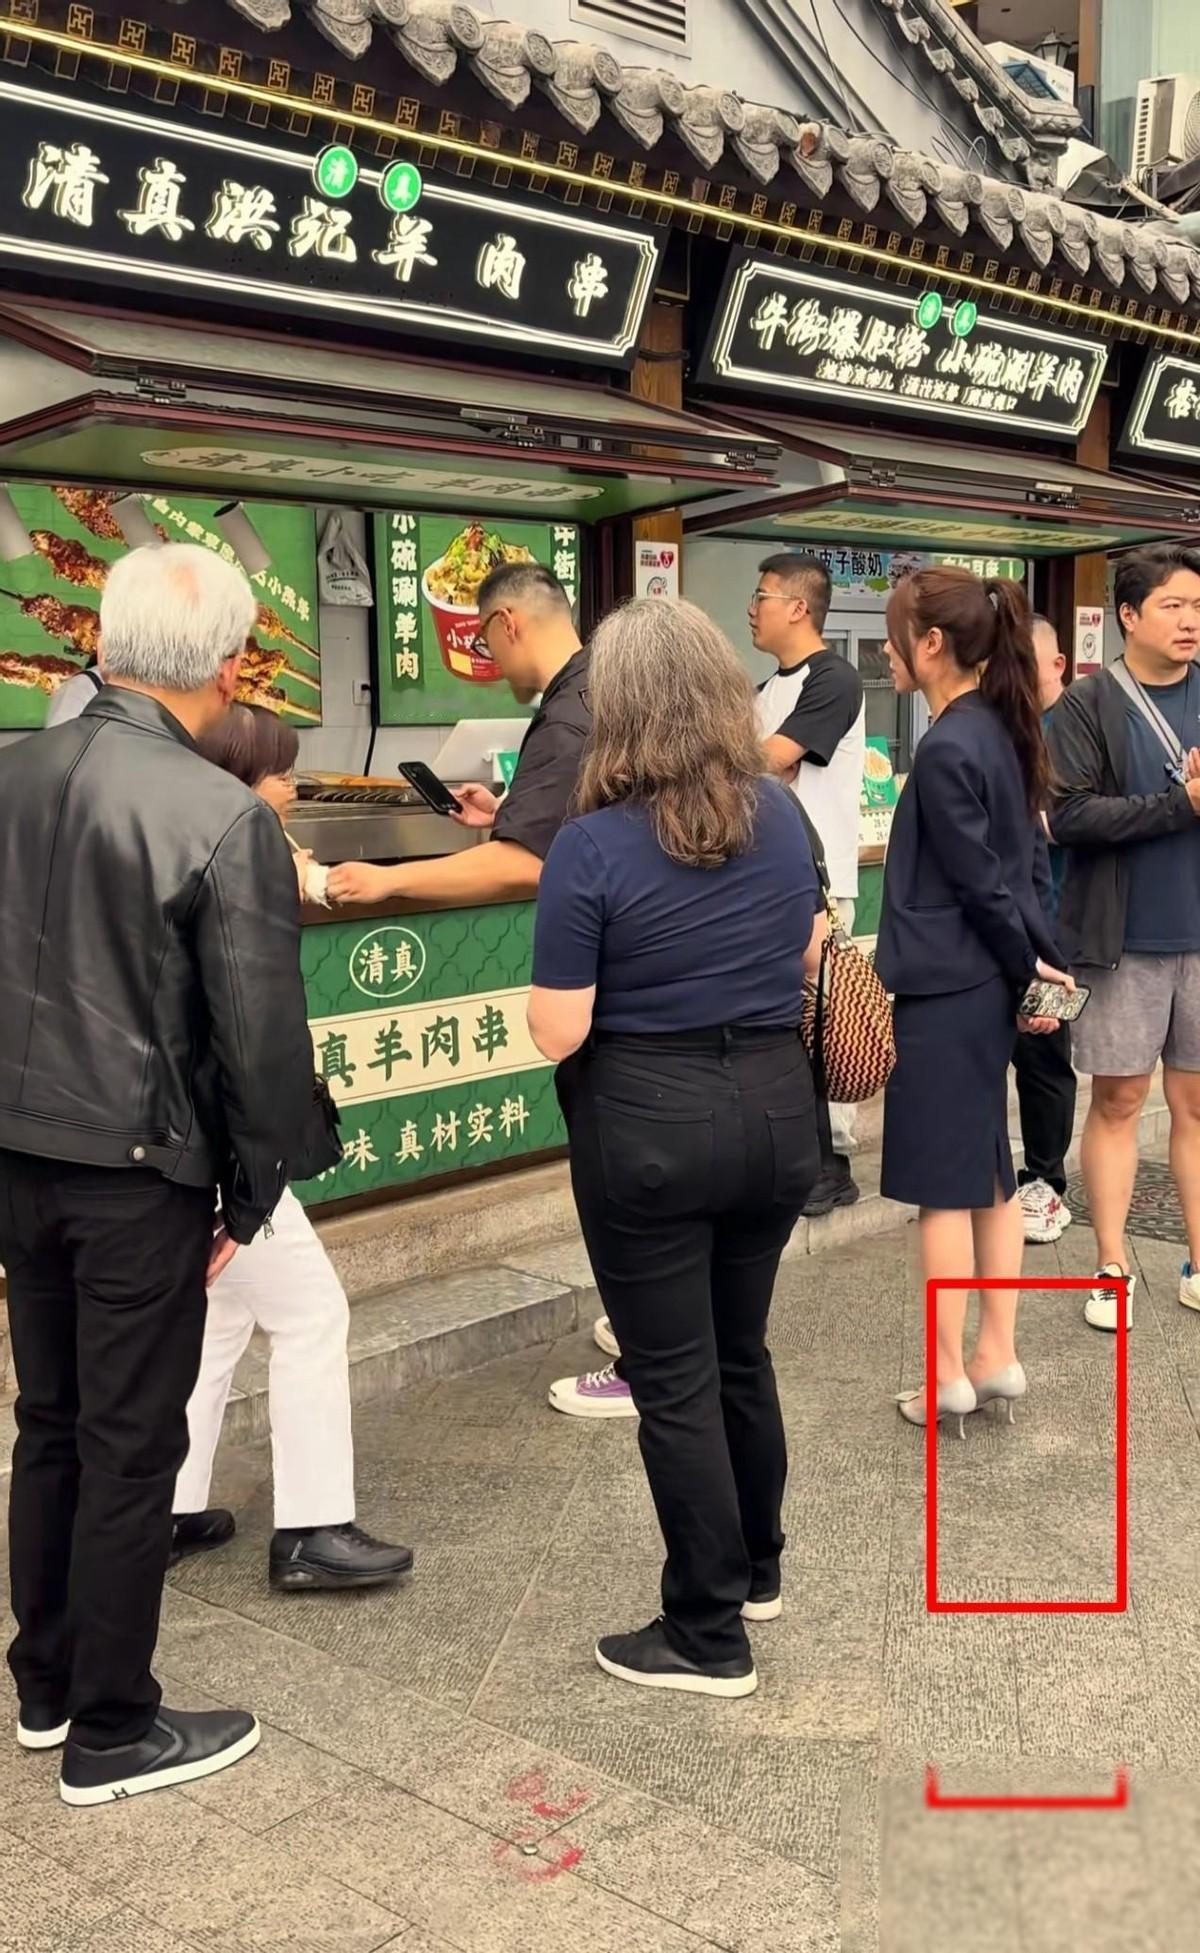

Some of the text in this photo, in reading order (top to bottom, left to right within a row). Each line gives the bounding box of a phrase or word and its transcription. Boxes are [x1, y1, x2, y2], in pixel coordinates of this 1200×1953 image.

[390, 514, 420, 680] 小碗涮羊肉
[554, 526, 577, 608] 牛街
[358, 940, 417, 985] 清真
[315, 1004, 509, 1088] 真羊肉串
[395, 1095, 530, 1164] 真材实料
